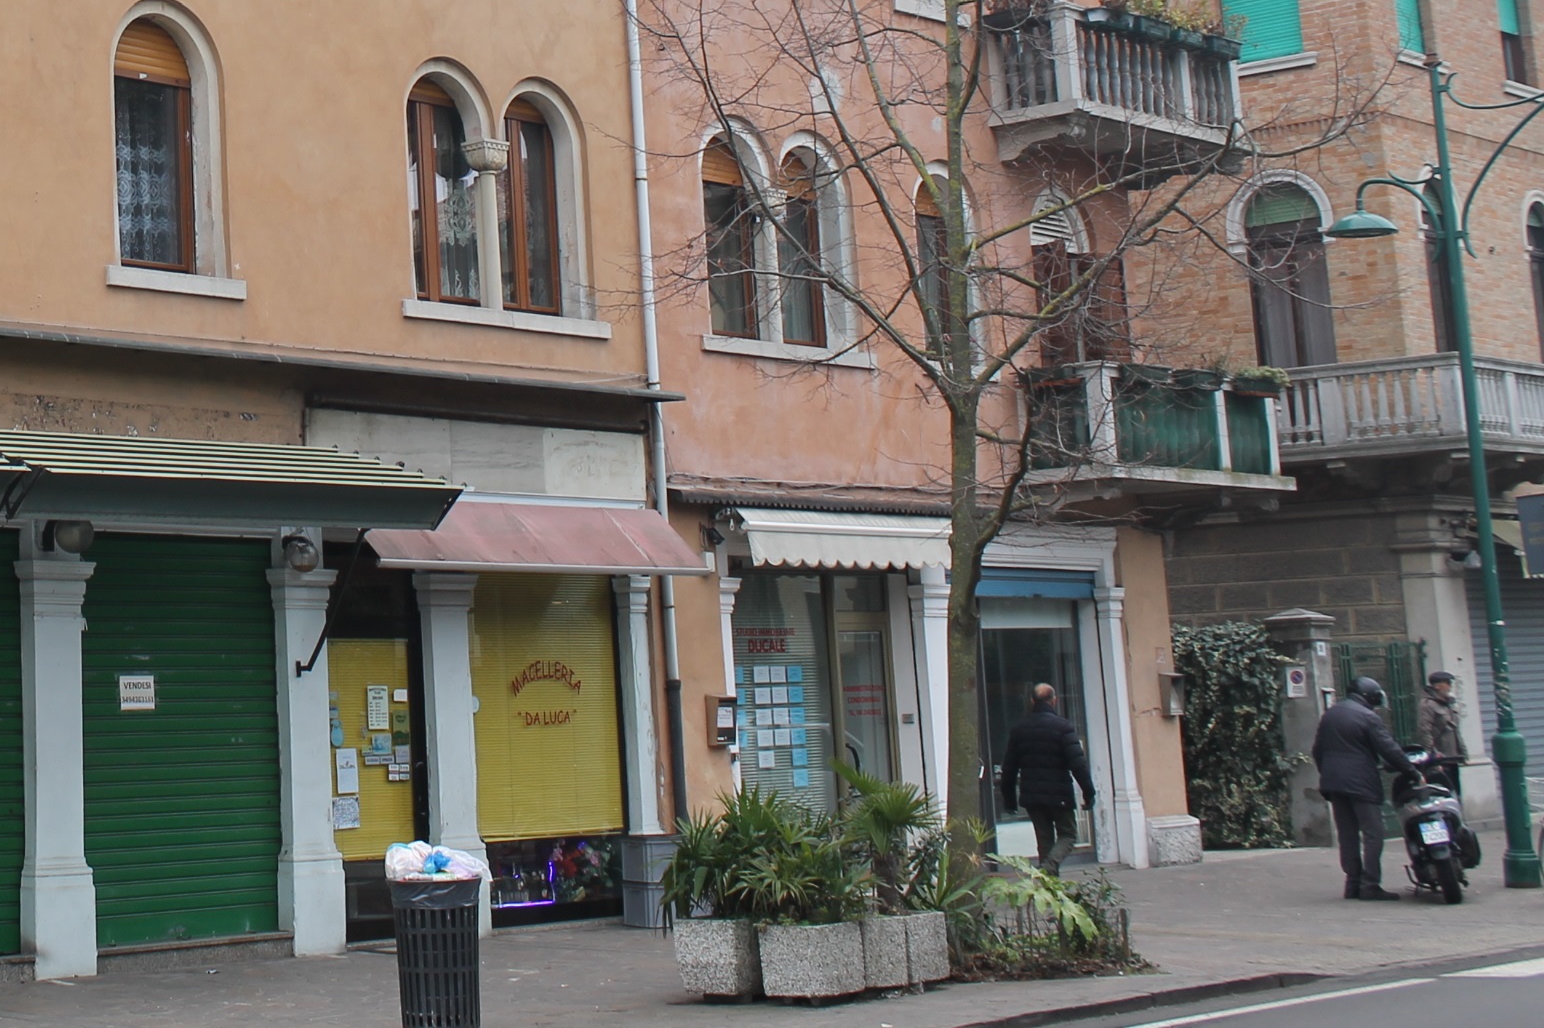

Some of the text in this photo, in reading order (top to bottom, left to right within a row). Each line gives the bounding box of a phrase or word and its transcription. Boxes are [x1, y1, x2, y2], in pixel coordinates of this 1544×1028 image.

[748, 638, 786, 653] DUCALE
[123, 681, 152, 690] VENDESI
[511, 659, 582, 698] MACELLERIA
